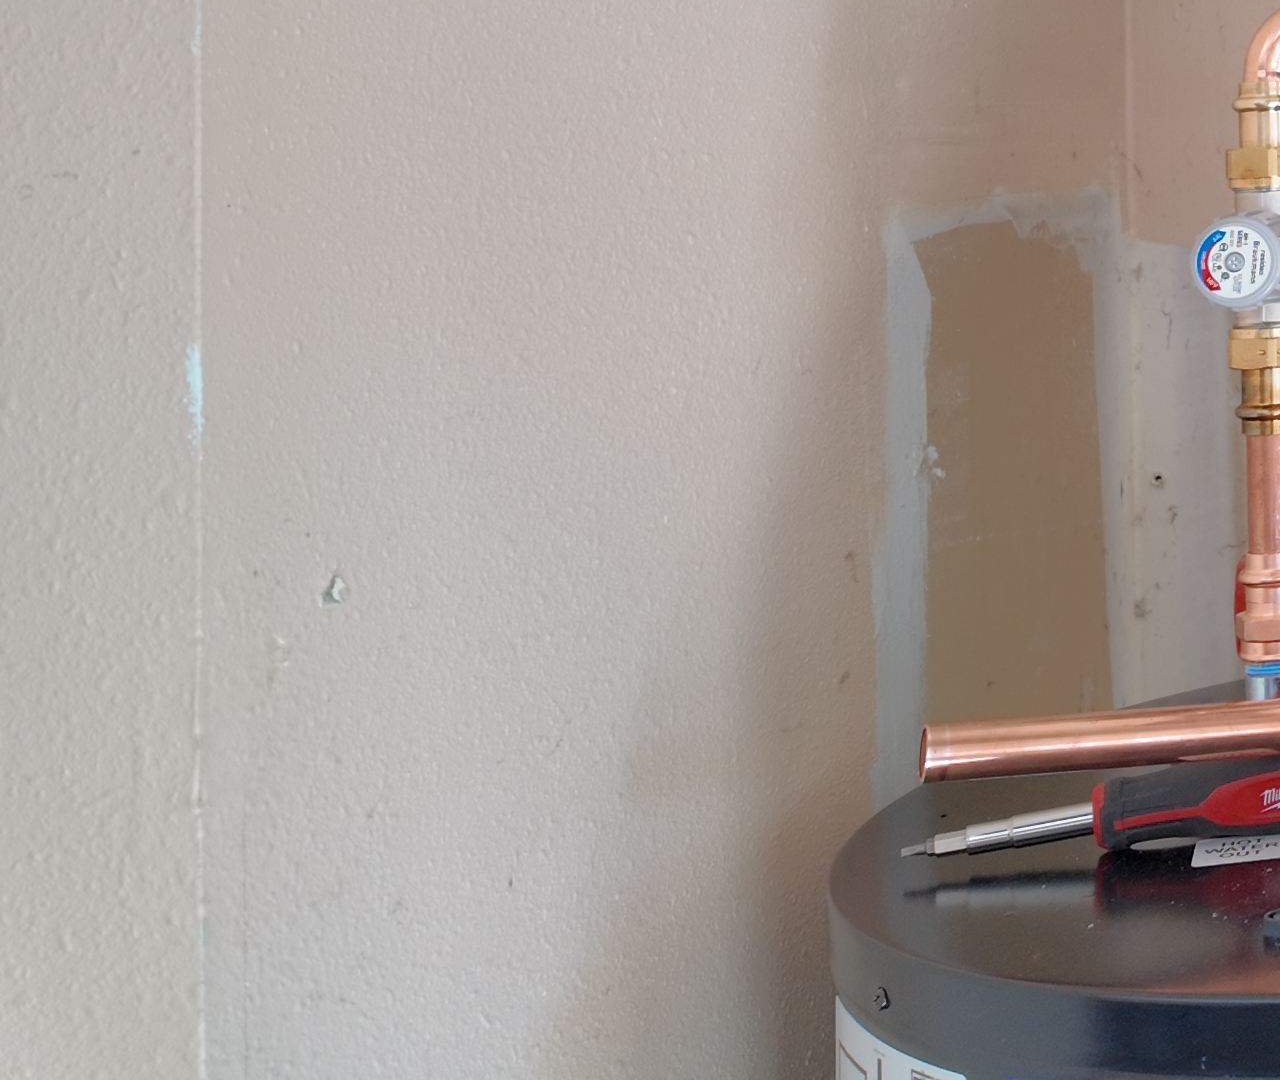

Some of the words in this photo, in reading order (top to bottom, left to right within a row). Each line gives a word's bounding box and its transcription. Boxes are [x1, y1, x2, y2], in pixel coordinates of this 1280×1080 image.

[1221, 838, 1264, 847] HOT
[1204, 841, 1279, 854] WATER
[1219, 849, 1261, 858] OUT
